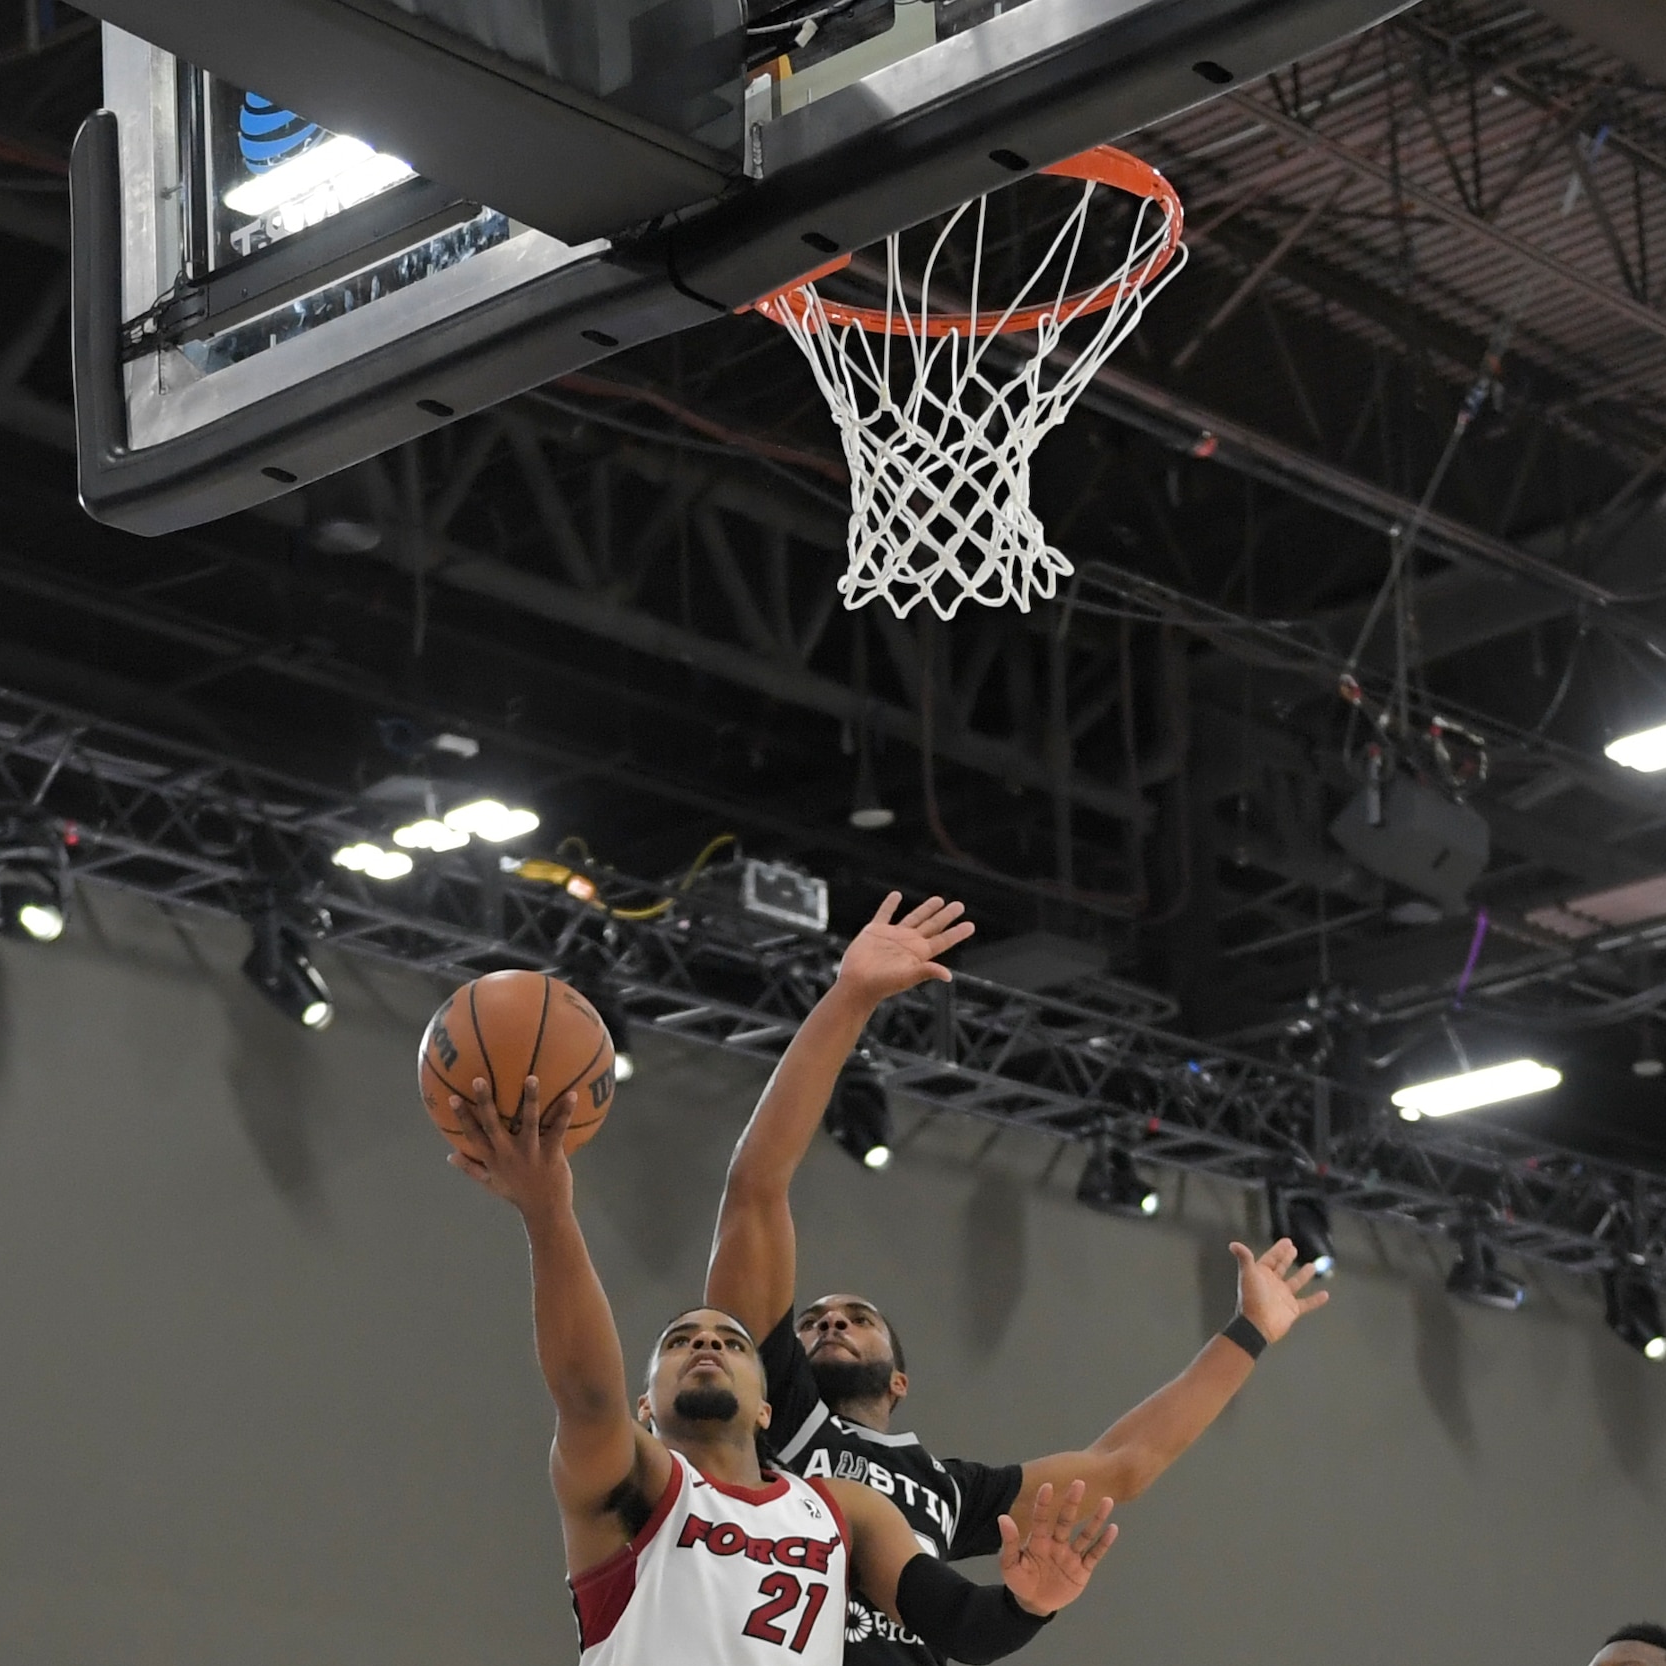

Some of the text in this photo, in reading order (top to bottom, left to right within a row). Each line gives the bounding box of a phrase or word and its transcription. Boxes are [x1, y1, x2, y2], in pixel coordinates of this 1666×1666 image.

[803, 1448, 955, 1550] AUSTIN
[677, 1513, 841, 1574] FORCE
[742, 1571, 830, 1655] 21
